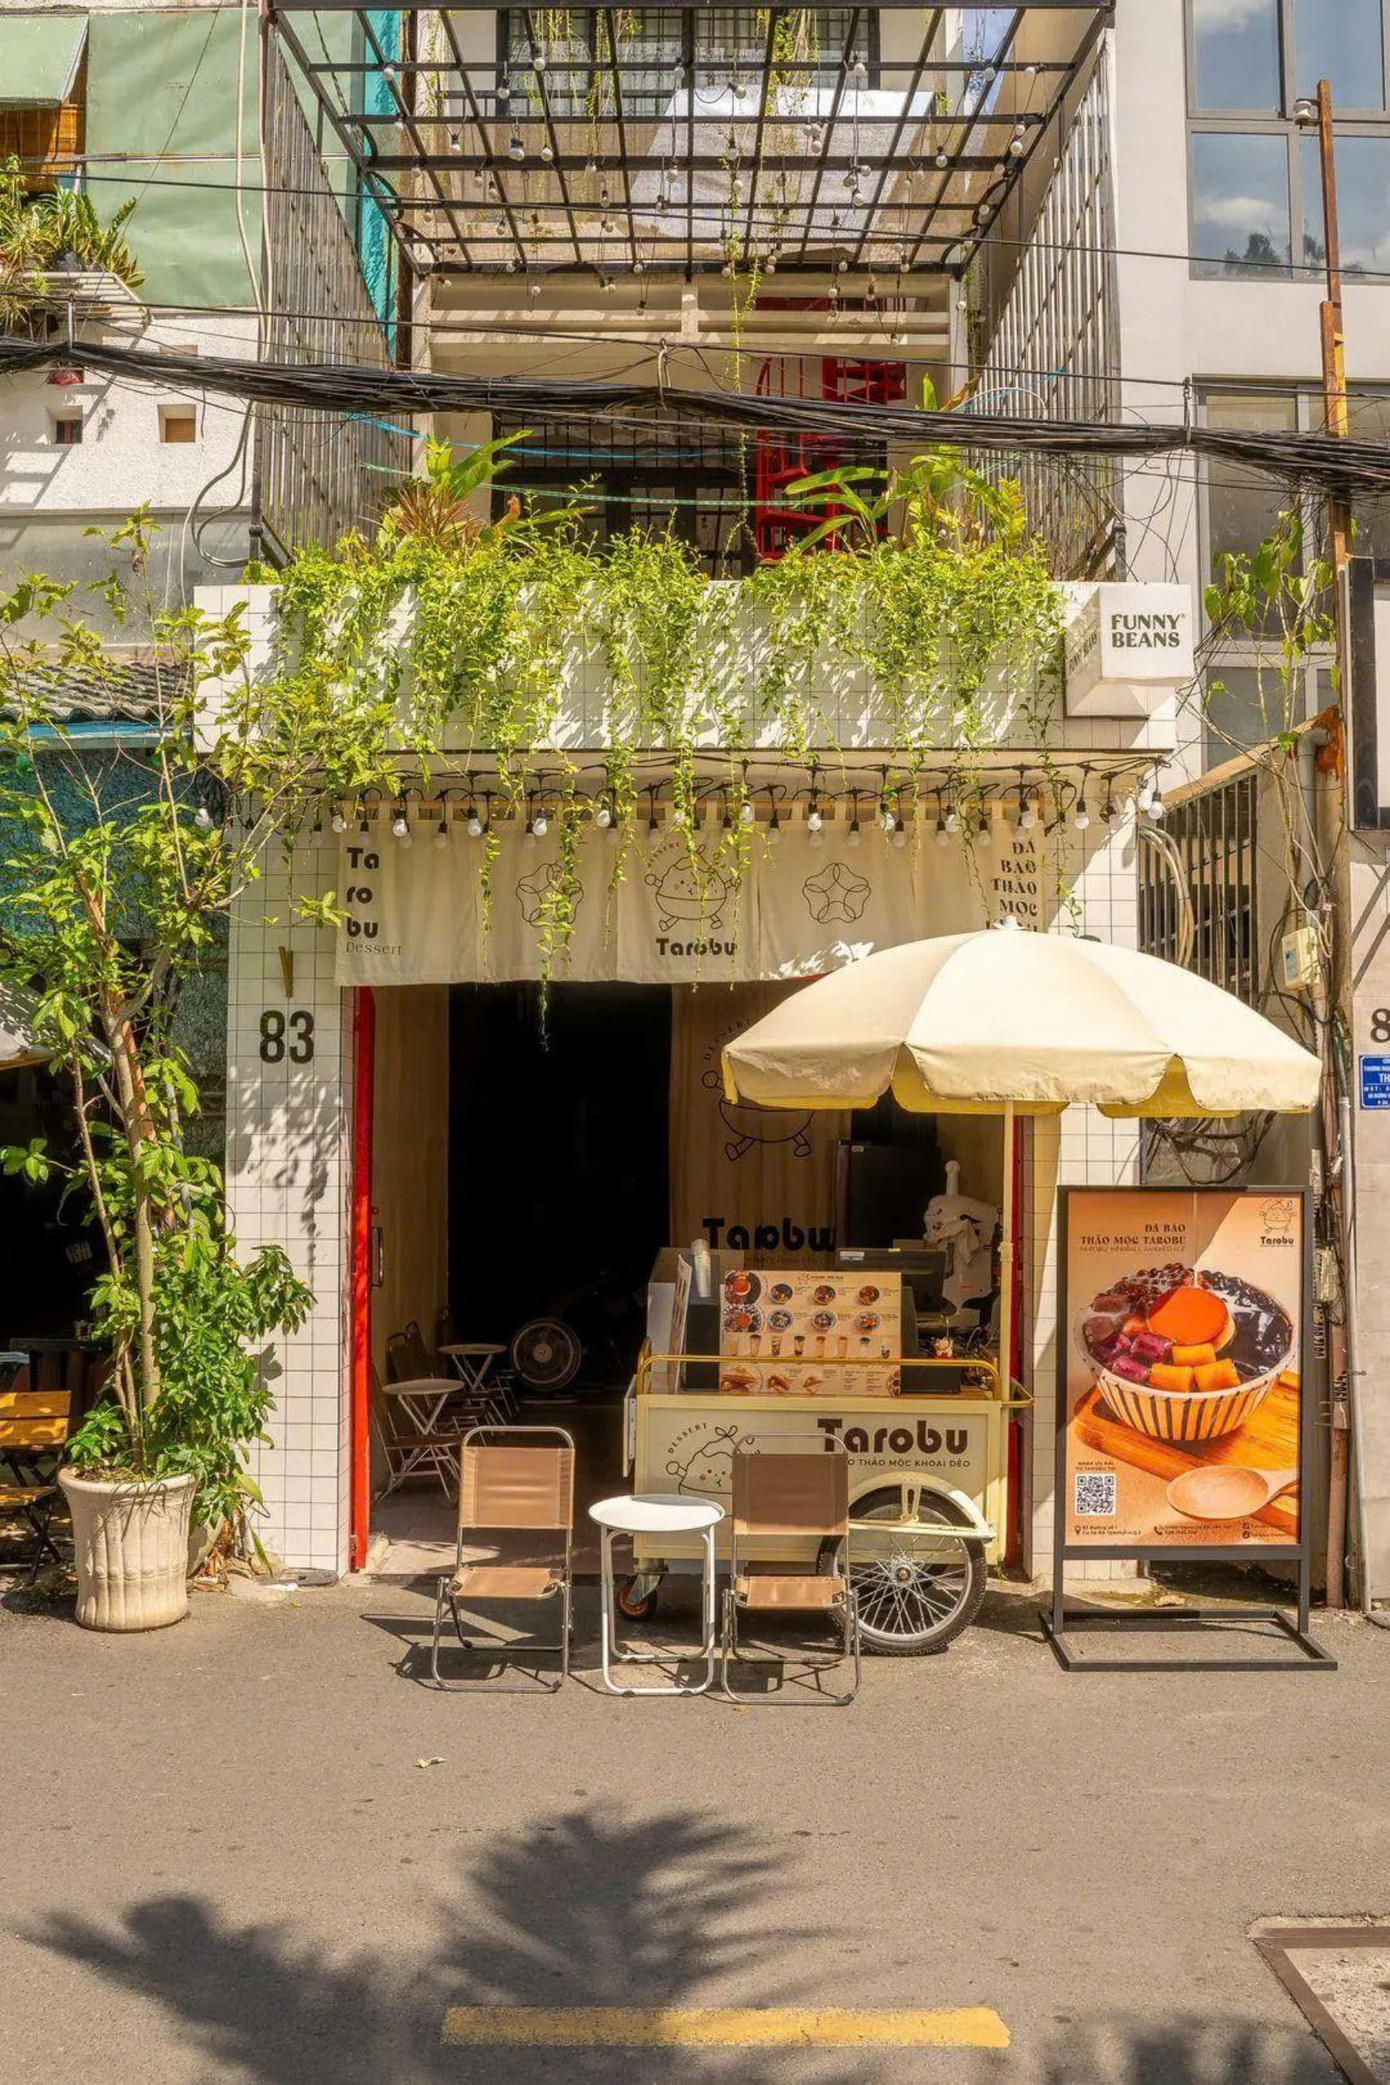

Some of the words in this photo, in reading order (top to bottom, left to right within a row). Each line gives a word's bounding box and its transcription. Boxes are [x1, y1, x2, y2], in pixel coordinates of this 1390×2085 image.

[1111, 613, 1180, 630] FUNNY
[1111, 632, 1180, 648] BEANS
[346, 847, 380, 870] Ta
[346, 886, 373, 904] ro
[346, 912, 379, 938] bu
[346, 941, 403, 956] Dessert
[655, 938, 738, 956] Tarobu
[260, 1010, 315, 1064] 83
[702, 1216, 834, 1252] Tarobu
[1142, 1236, 1187, 1246] TAROBU
[1260, 1236, 1295, 1245] Tarobu
[667, 1422, 708, 1455] DESSERT
[817, 1418, 969, 1455] Tarobu
[914, 1459, 947, 1468] KHOAI
